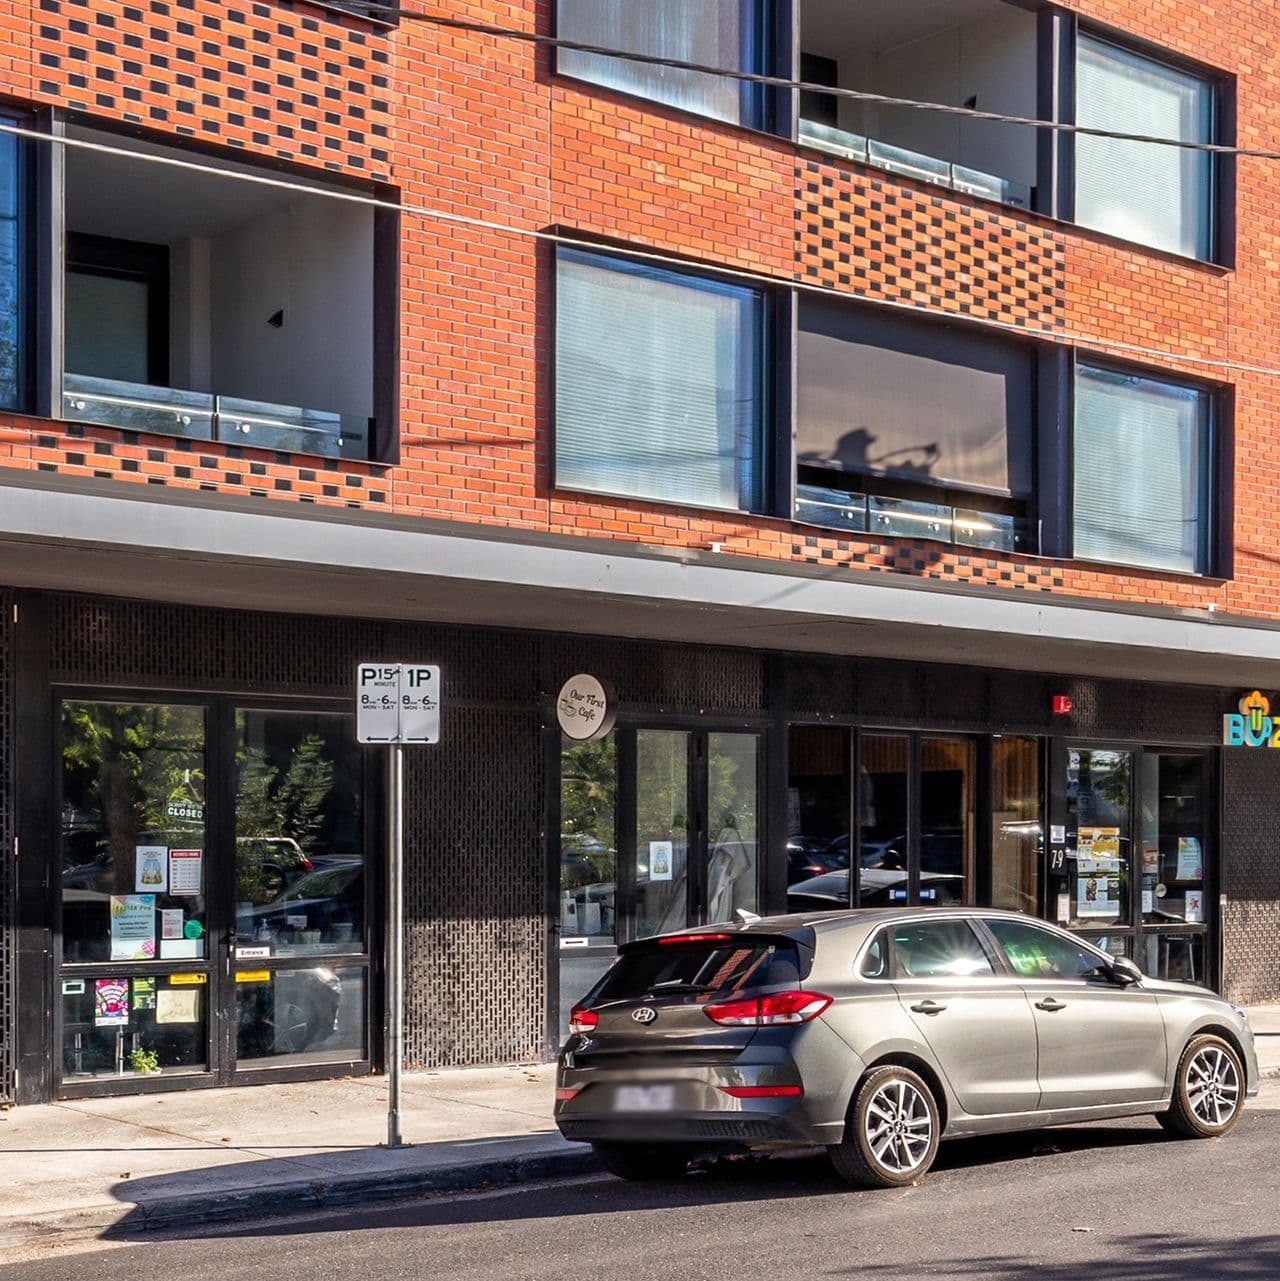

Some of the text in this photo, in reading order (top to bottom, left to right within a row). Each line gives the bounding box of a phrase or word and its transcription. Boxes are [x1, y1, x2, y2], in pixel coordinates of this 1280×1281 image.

[407, 669, 431, 687] 1P
[570, 689, 604, 709] Our First
[578, 706, 595, 721] Cafe
[167, 807, 203, 818] CLOSED
[1051, 849, 1064, 868] 7-9
